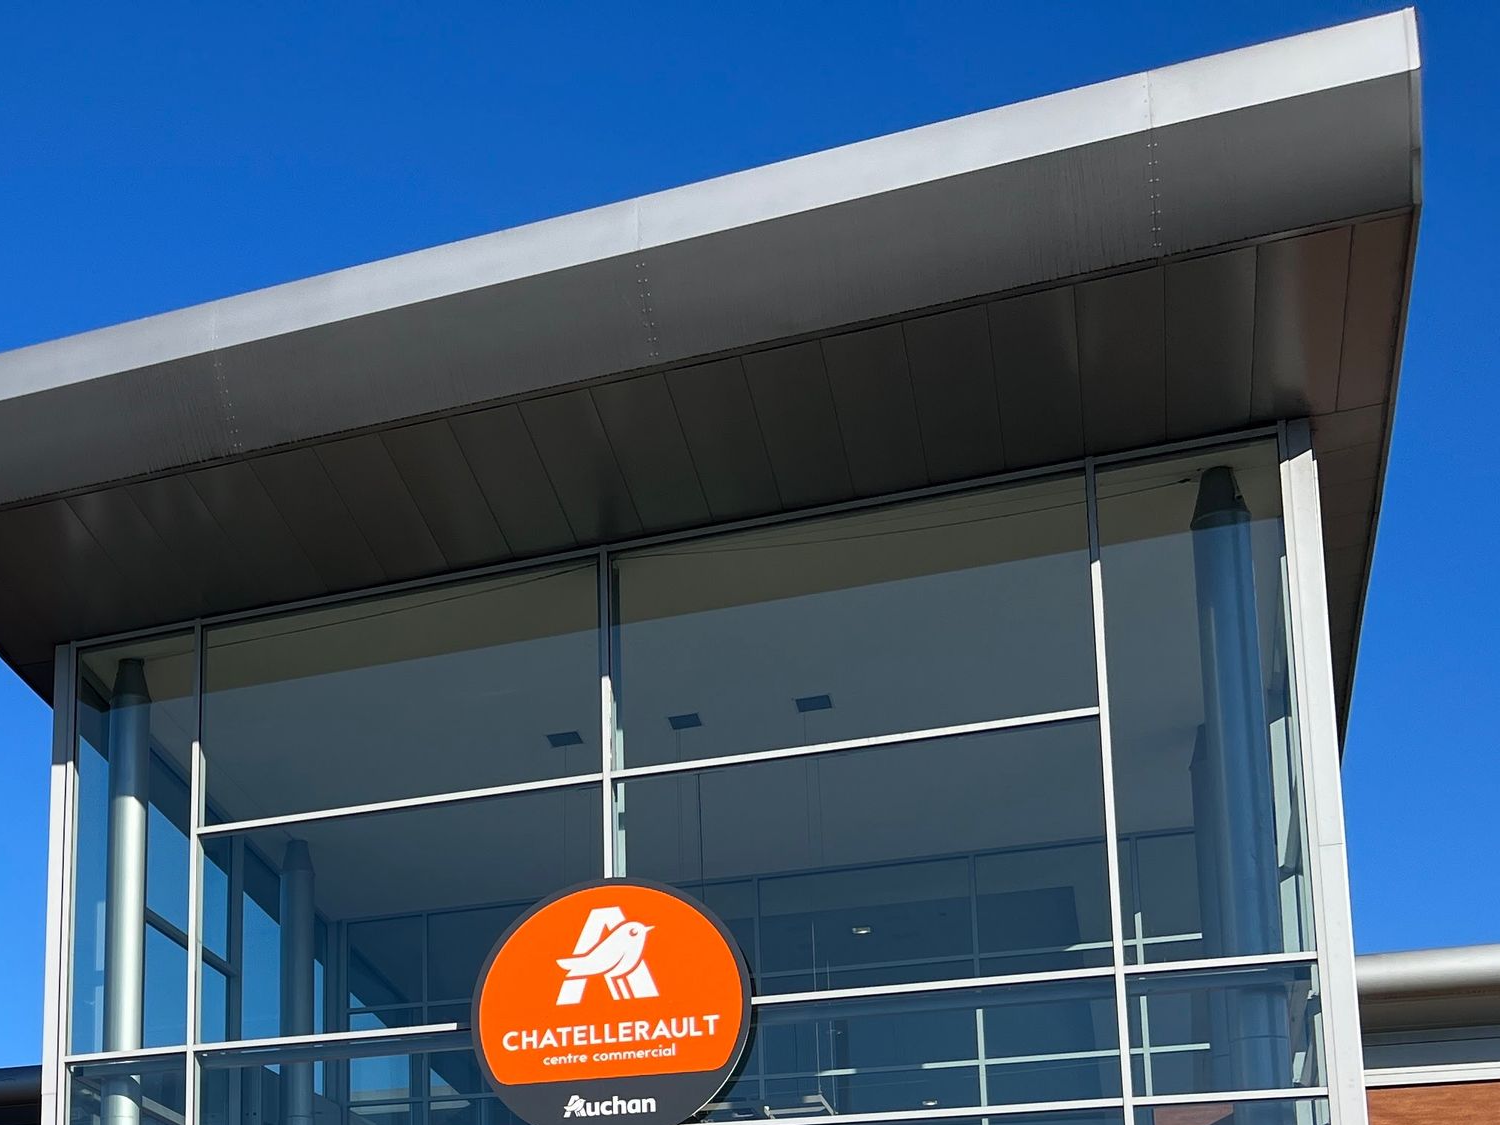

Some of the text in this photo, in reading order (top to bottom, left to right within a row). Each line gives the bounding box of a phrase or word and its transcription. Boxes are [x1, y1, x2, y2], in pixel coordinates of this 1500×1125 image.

[502, 1014, 720, 1051] CHATELLERAULT
[543, 1044, 676, 1066] centre commercial
[563, 1094, 657, 1118] Auchan
